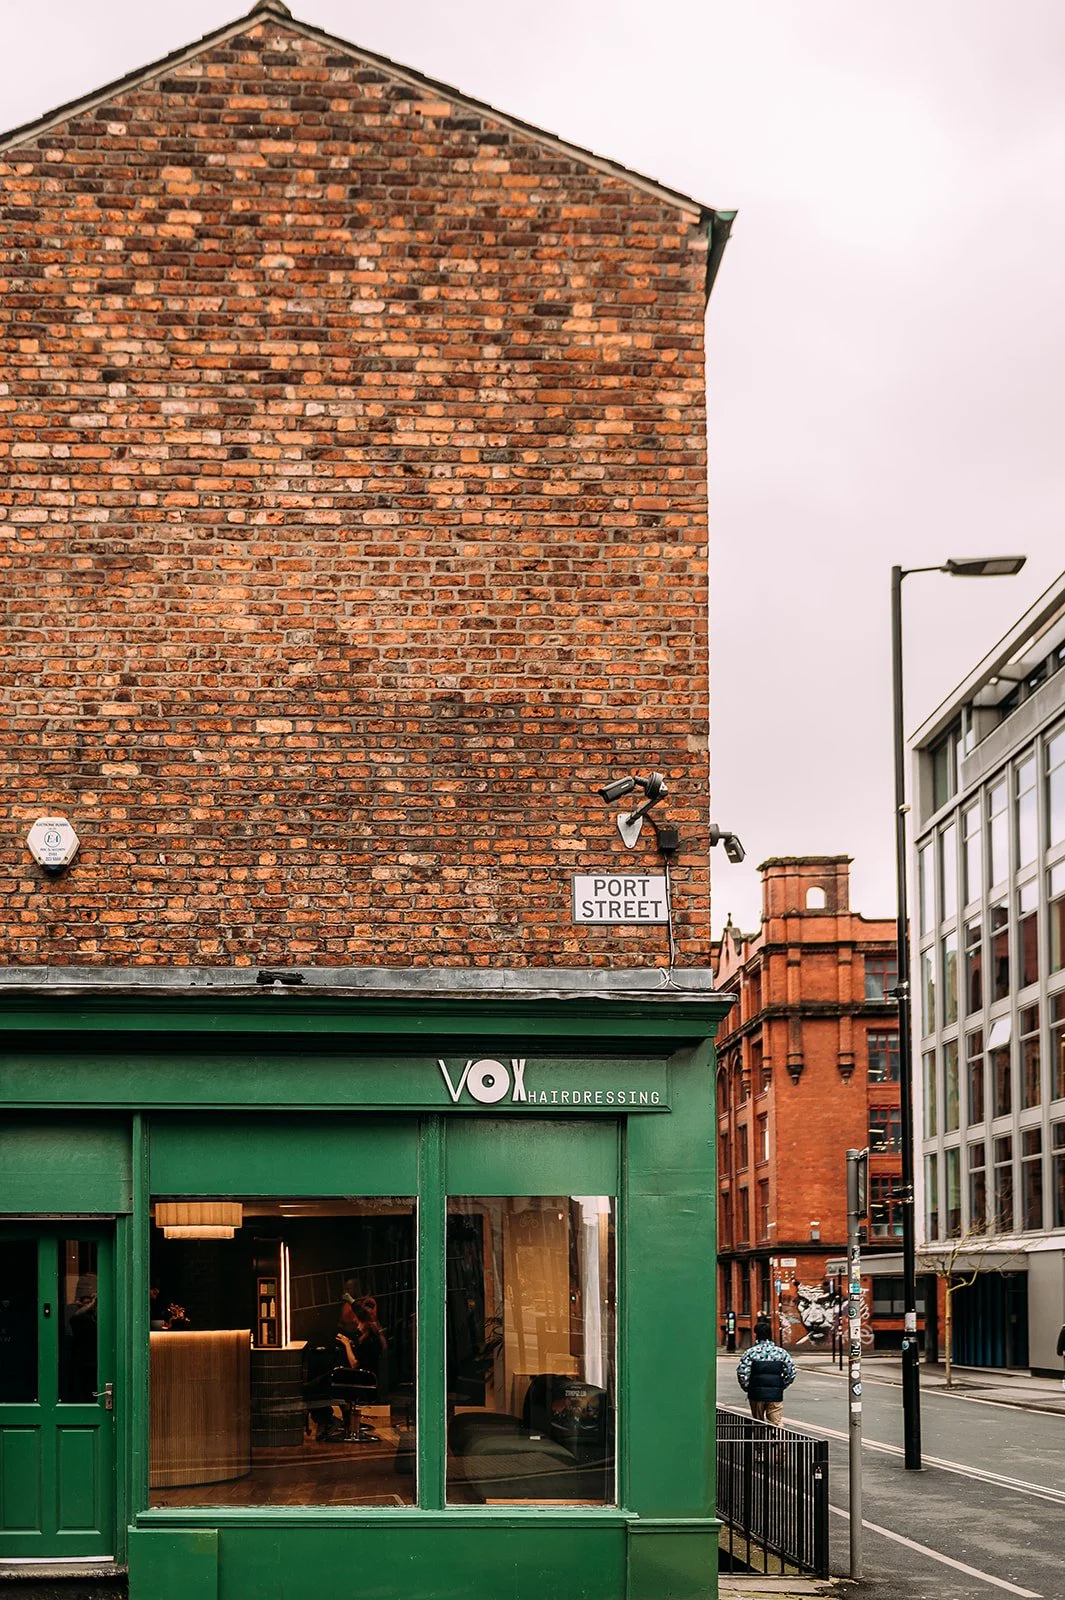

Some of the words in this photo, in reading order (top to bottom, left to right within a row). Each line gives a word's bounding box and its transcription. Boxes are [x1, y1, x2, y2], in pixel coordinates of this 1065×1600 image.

[594, 879, 650, 896] PORT
[582, 901, 662, 918] STREET
[438, 1058, 527, 1104] VOX
[527, 1090, 661, 1105] HAIRDRESSING
